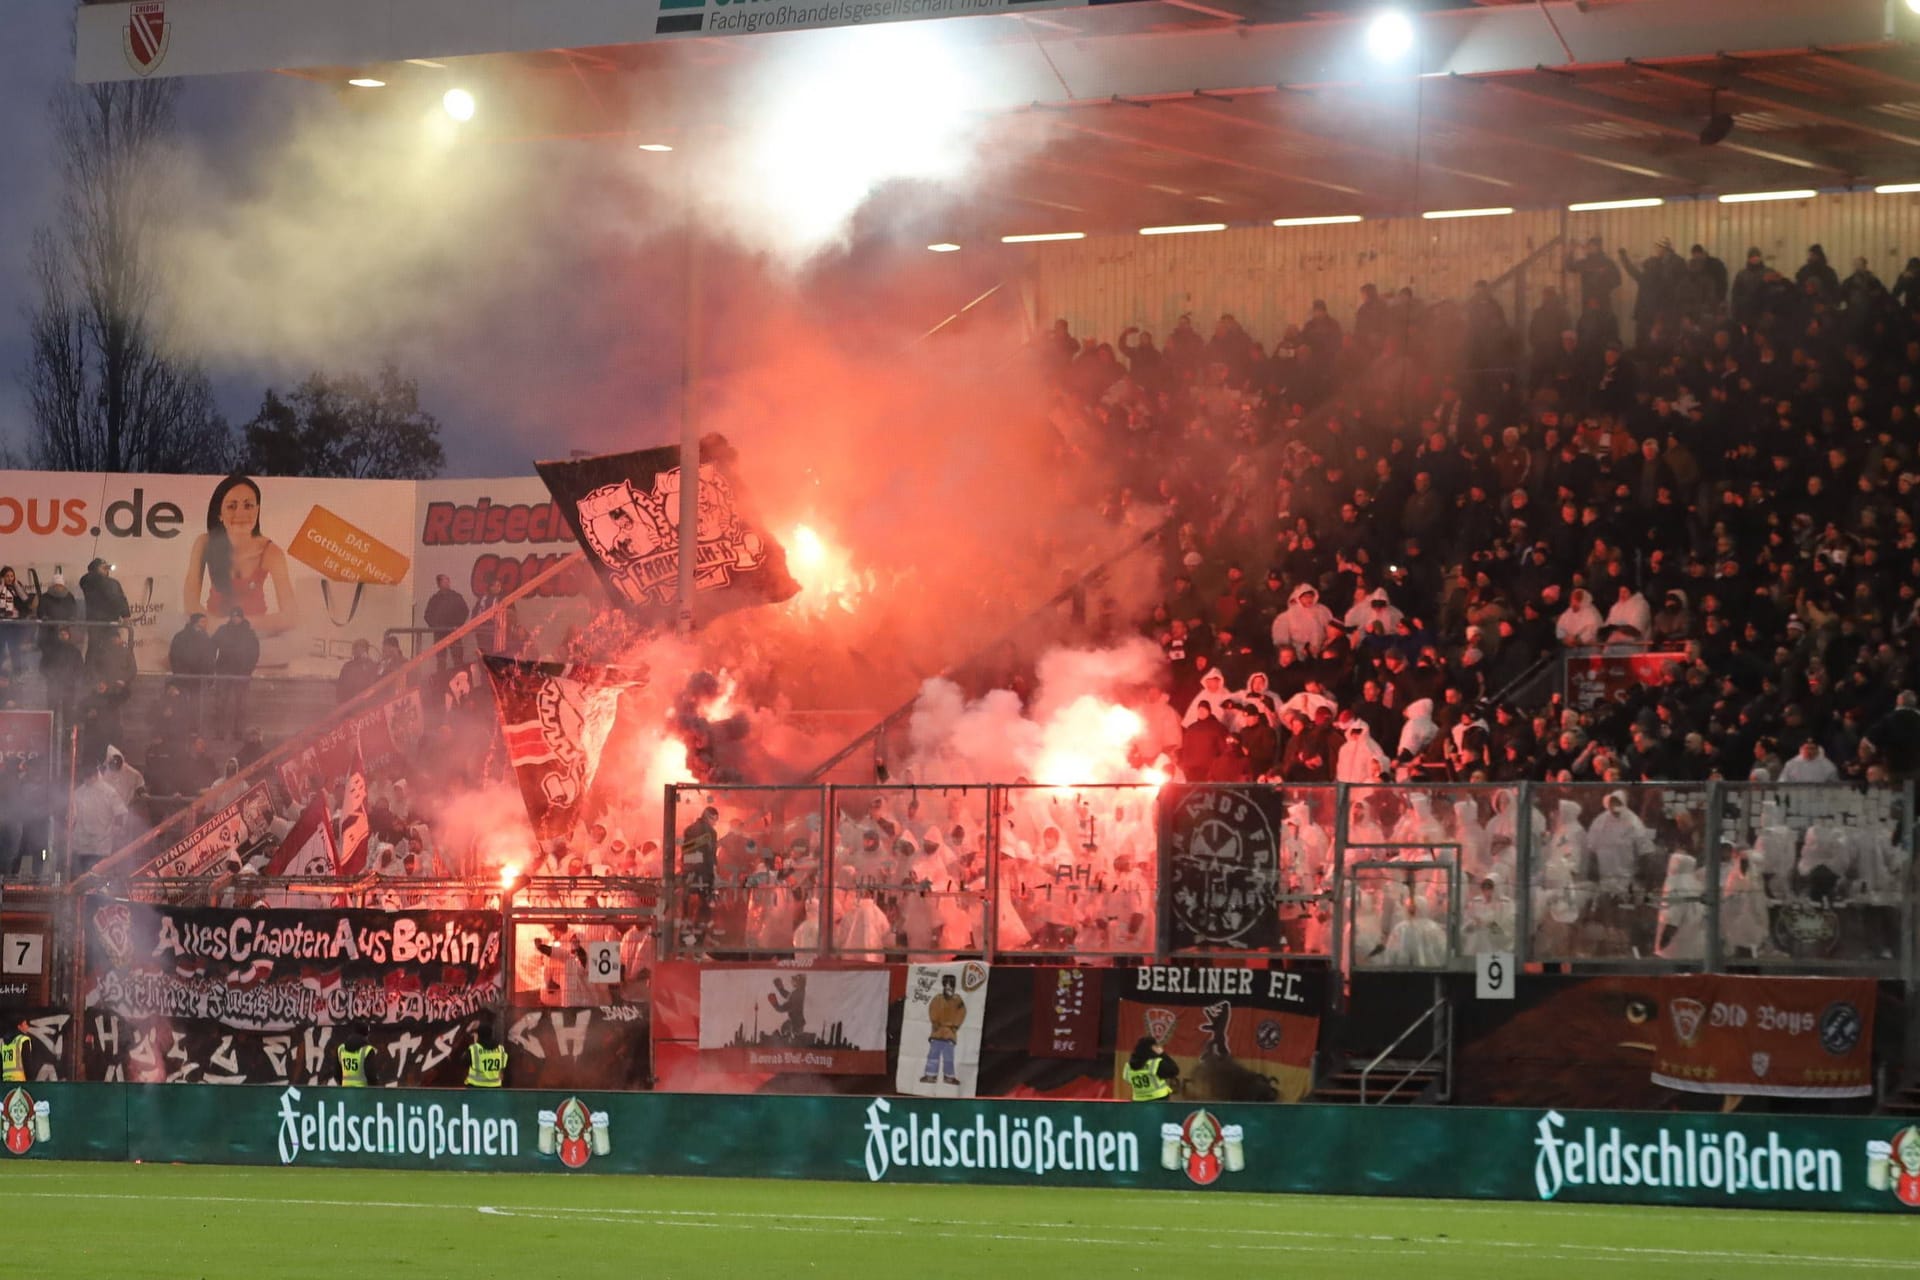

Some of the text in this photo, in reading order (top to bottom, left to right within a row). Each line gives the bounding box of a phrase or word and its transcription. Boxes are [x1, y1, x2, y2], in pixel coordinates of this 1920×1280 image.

[307, 528, 364, 568] Cottbuser
[345, 532, 371, 553] DAS
[323, 556, 339, 572] ist
[155, 803, 239, 868] DYNAMO FAMILIE
[15, 941, 31, 966] 7
[598, 948, 611, 975] 8
[1137, 966, 1304, 1003] BERLINER F.C.
[1488, 961, 1503, 990] 9
[1710, 1002, 1815, 1035] Old Boys
[342, 1056, 359, 1071] 135
[482, 1058, 500, 1072] 129
[278, 1086, 517, 1165] Feldschlößchen
[864, 1097, 1139, 1182] Feldschlößchen
[1535, 1110, 1842, 1200] Feldschlößchen
